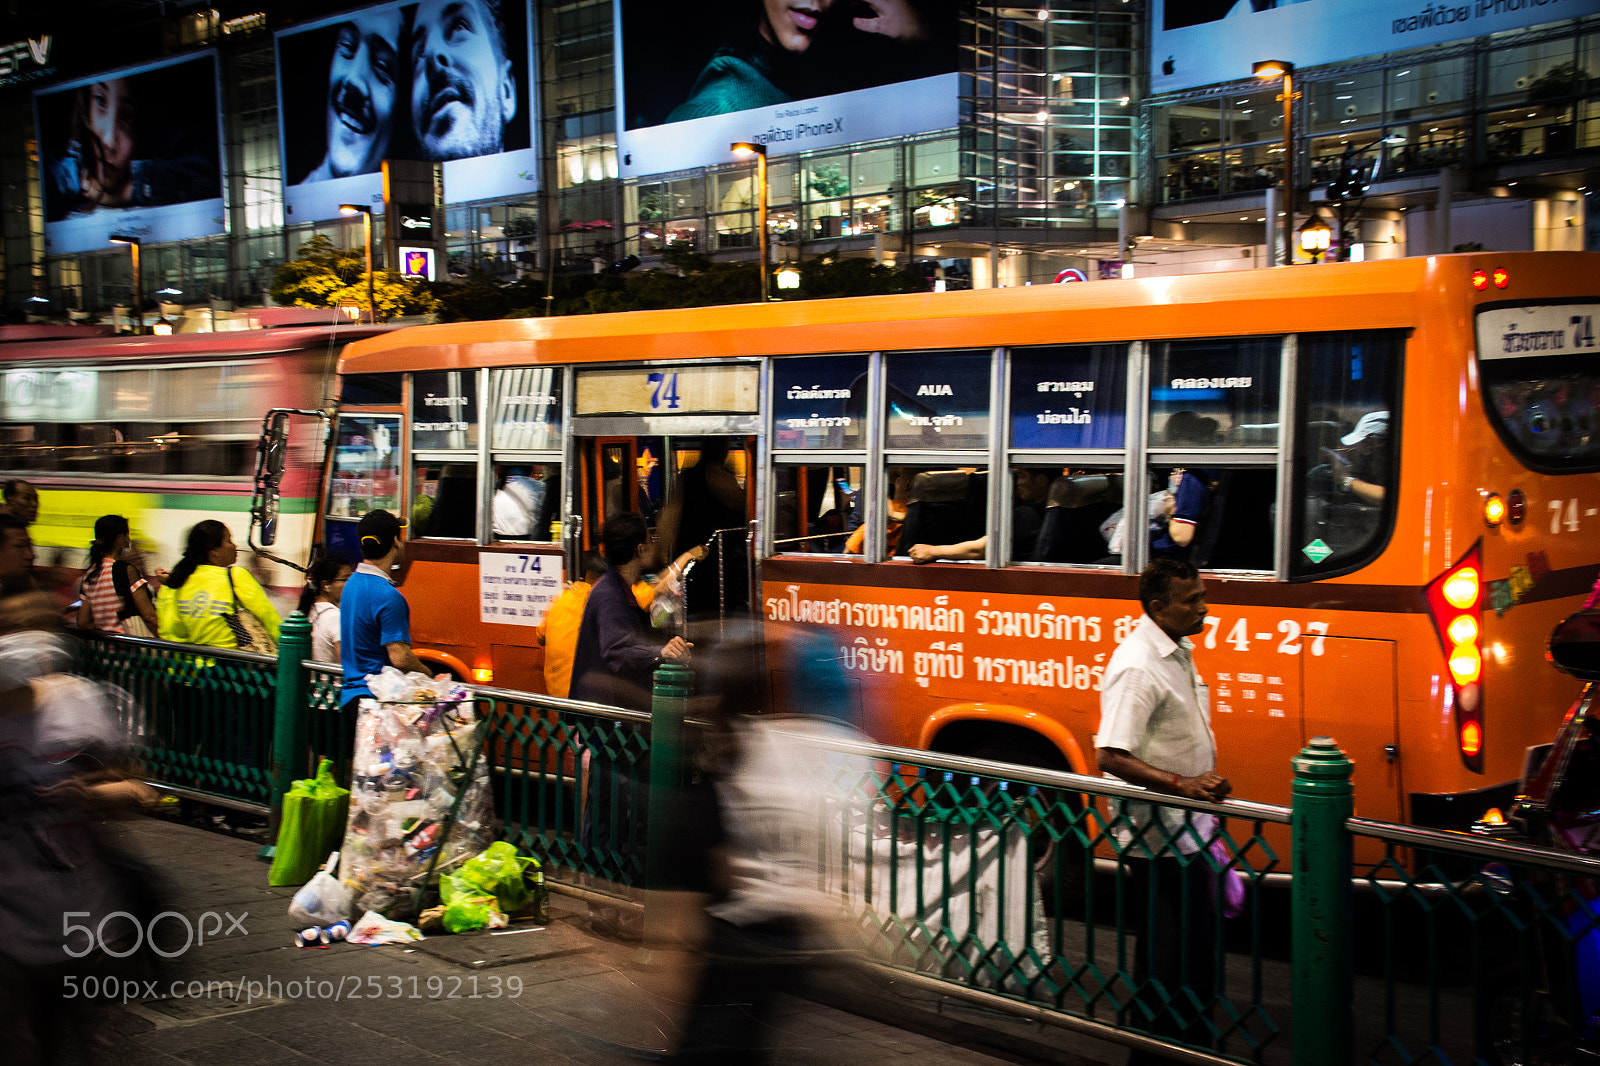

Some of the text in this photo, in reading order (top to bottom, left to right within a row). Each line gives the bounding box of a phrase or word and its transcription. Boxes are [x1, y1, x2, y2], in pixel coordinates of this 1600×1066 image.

[1568, 315, 1595, 349] 74
[646, 372, 681, 409] 74
[916, 384, 953, 396] AUA
[1036, 381, 1095, 398] สวนลุม
[1171, 376, 1252, 389] คลองเตย
[1036, 407, 1092, 425] บ่อนไก่
[518, 555, 542, 574] 74
[766, 585, 965, 633] รถโดยสารขนาดเล็ก
[974, 599, 1102, 643] ร่วมบริการ
[1202, 616, 1330, 656] 74-27
[840, 637, 1107, 691] บริษัท ยูทีบี ทรานสปอร์
